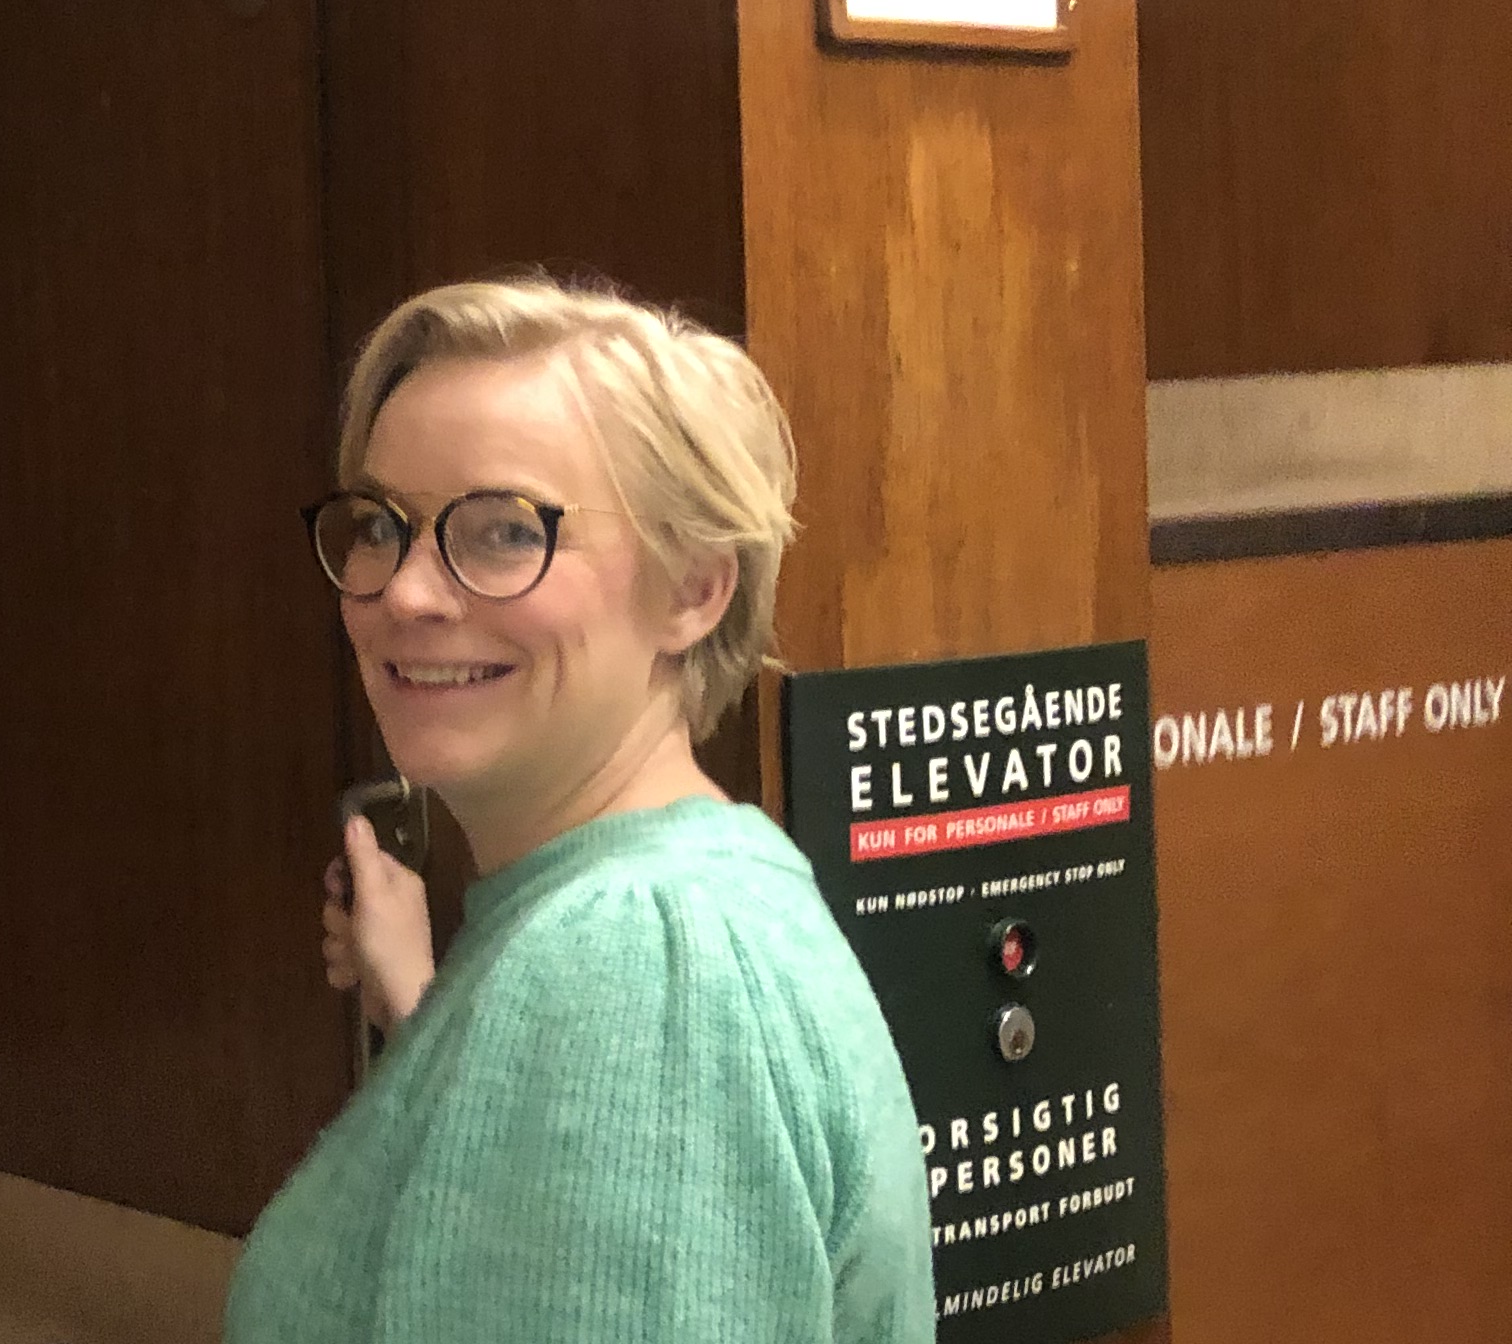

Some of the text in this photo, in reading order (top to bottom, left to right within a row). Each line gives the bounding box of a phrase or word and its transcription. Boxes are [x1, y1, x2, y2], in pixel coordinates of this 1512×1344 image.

[846, 683, 1122, 752] STEDSEGÅENDE
[1153, 675, 1506, 770] ONALE / STAFF ONLY
[850, 734, 1122, 813] ELEVATOR
[857, 829, 896, 853] KUN
[904, 824, 937, 846] FOR
[945, 812, 1036, 841] PERSONALE
[1051, 800, 1088, 824] STAFF
[1092, 795, 1127, 816] ONLY
[855, 895, 889, 916] KUN
[894, 884, 965, 909] NØDSTOP
[981, 869, 1061, 899] EMERGENCY
[1064, 864, 1094, 884] STOP
[1096, 857, 1126, 879] ONLY
[920, 1081, 1121, 1155] ORSIGTIG
[930, 1125, 1118, 1198] PERSONER
[931, 1176, 1136, 1248] TRANSPORT FORBUDT
[1051, 1242, 1137, 1290] ELEVATOR
